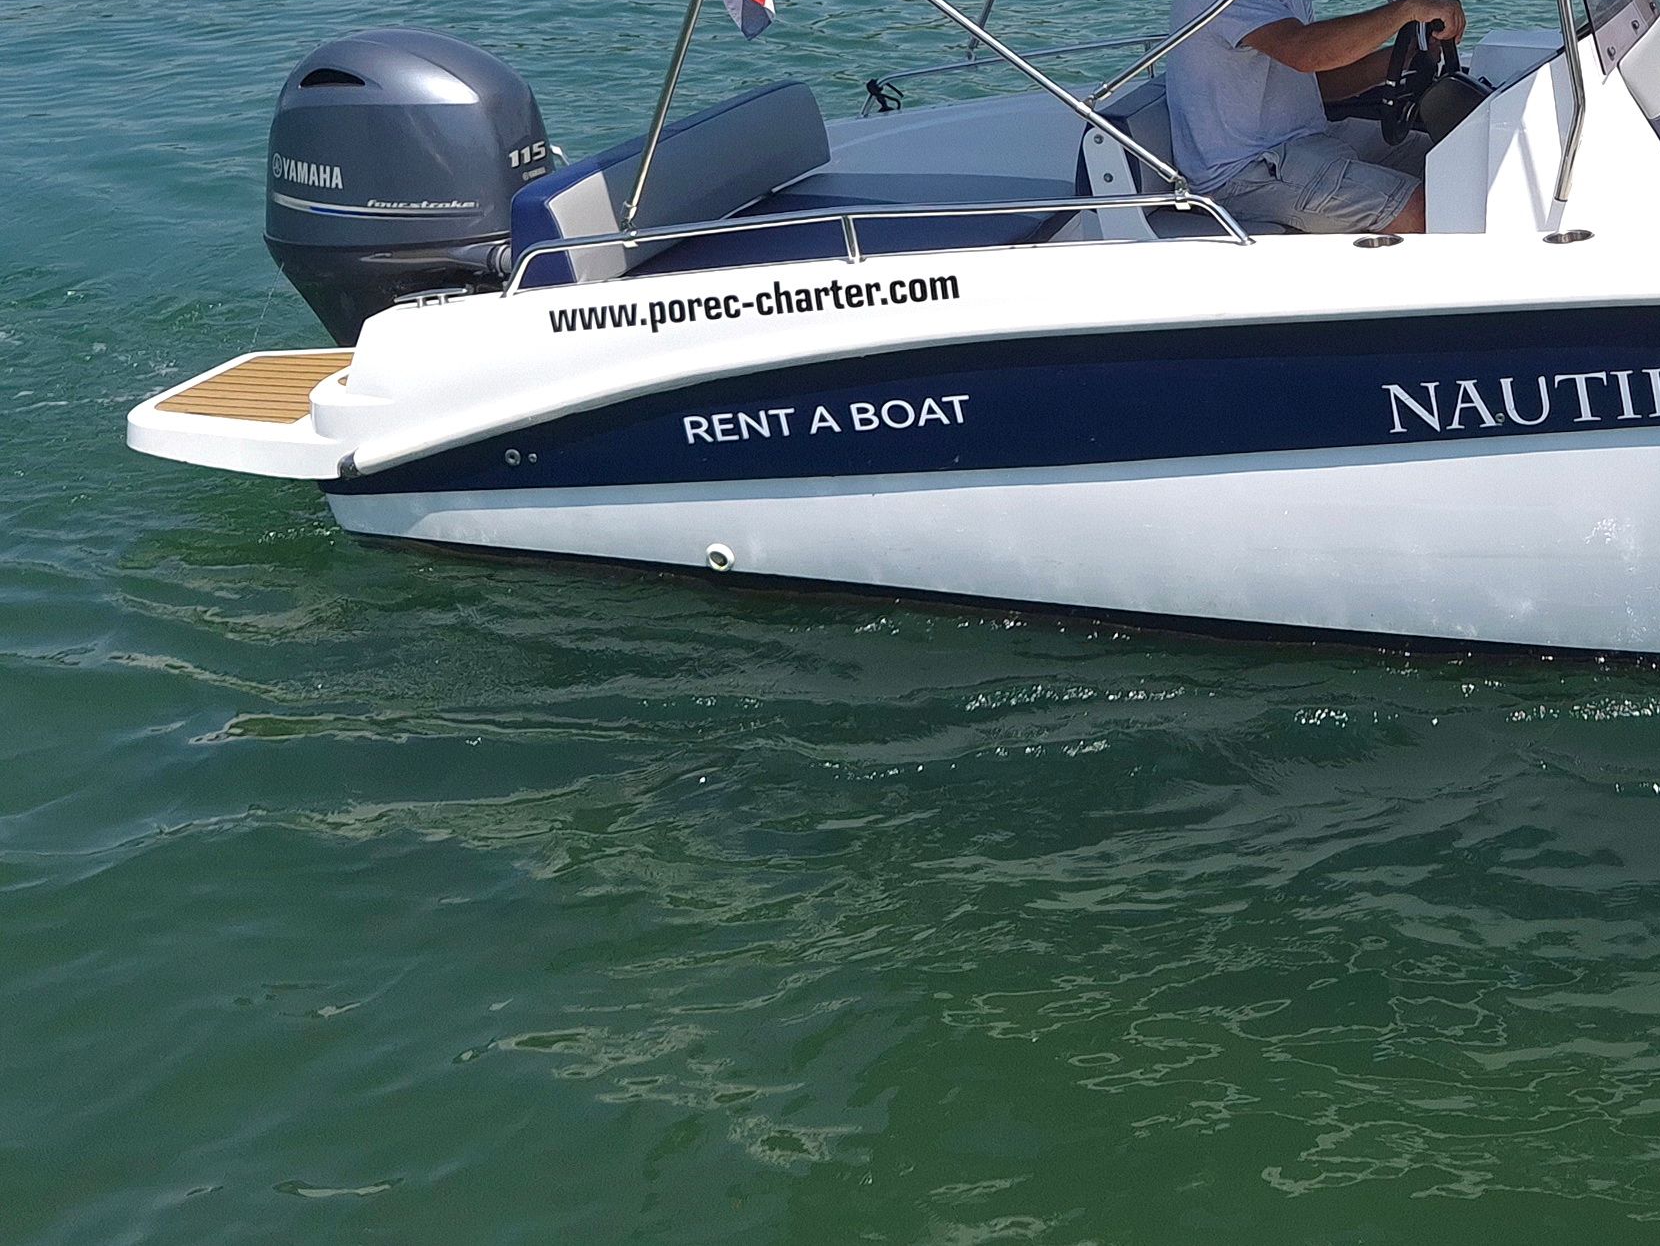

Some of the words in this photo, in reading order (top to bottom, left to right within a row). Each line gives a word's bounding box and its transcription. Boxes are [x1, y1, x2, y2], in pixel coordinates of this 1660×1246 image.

[282, 156, 344, 190] YAMAHA
[509, 140, 546, 168] 115
[549, 274, 960, 333] www.porec-charter.com
[683, 407, 796, 445] RENT
[809, 405, 842, 435] A
[849, 394, 970, 432] BOAT
